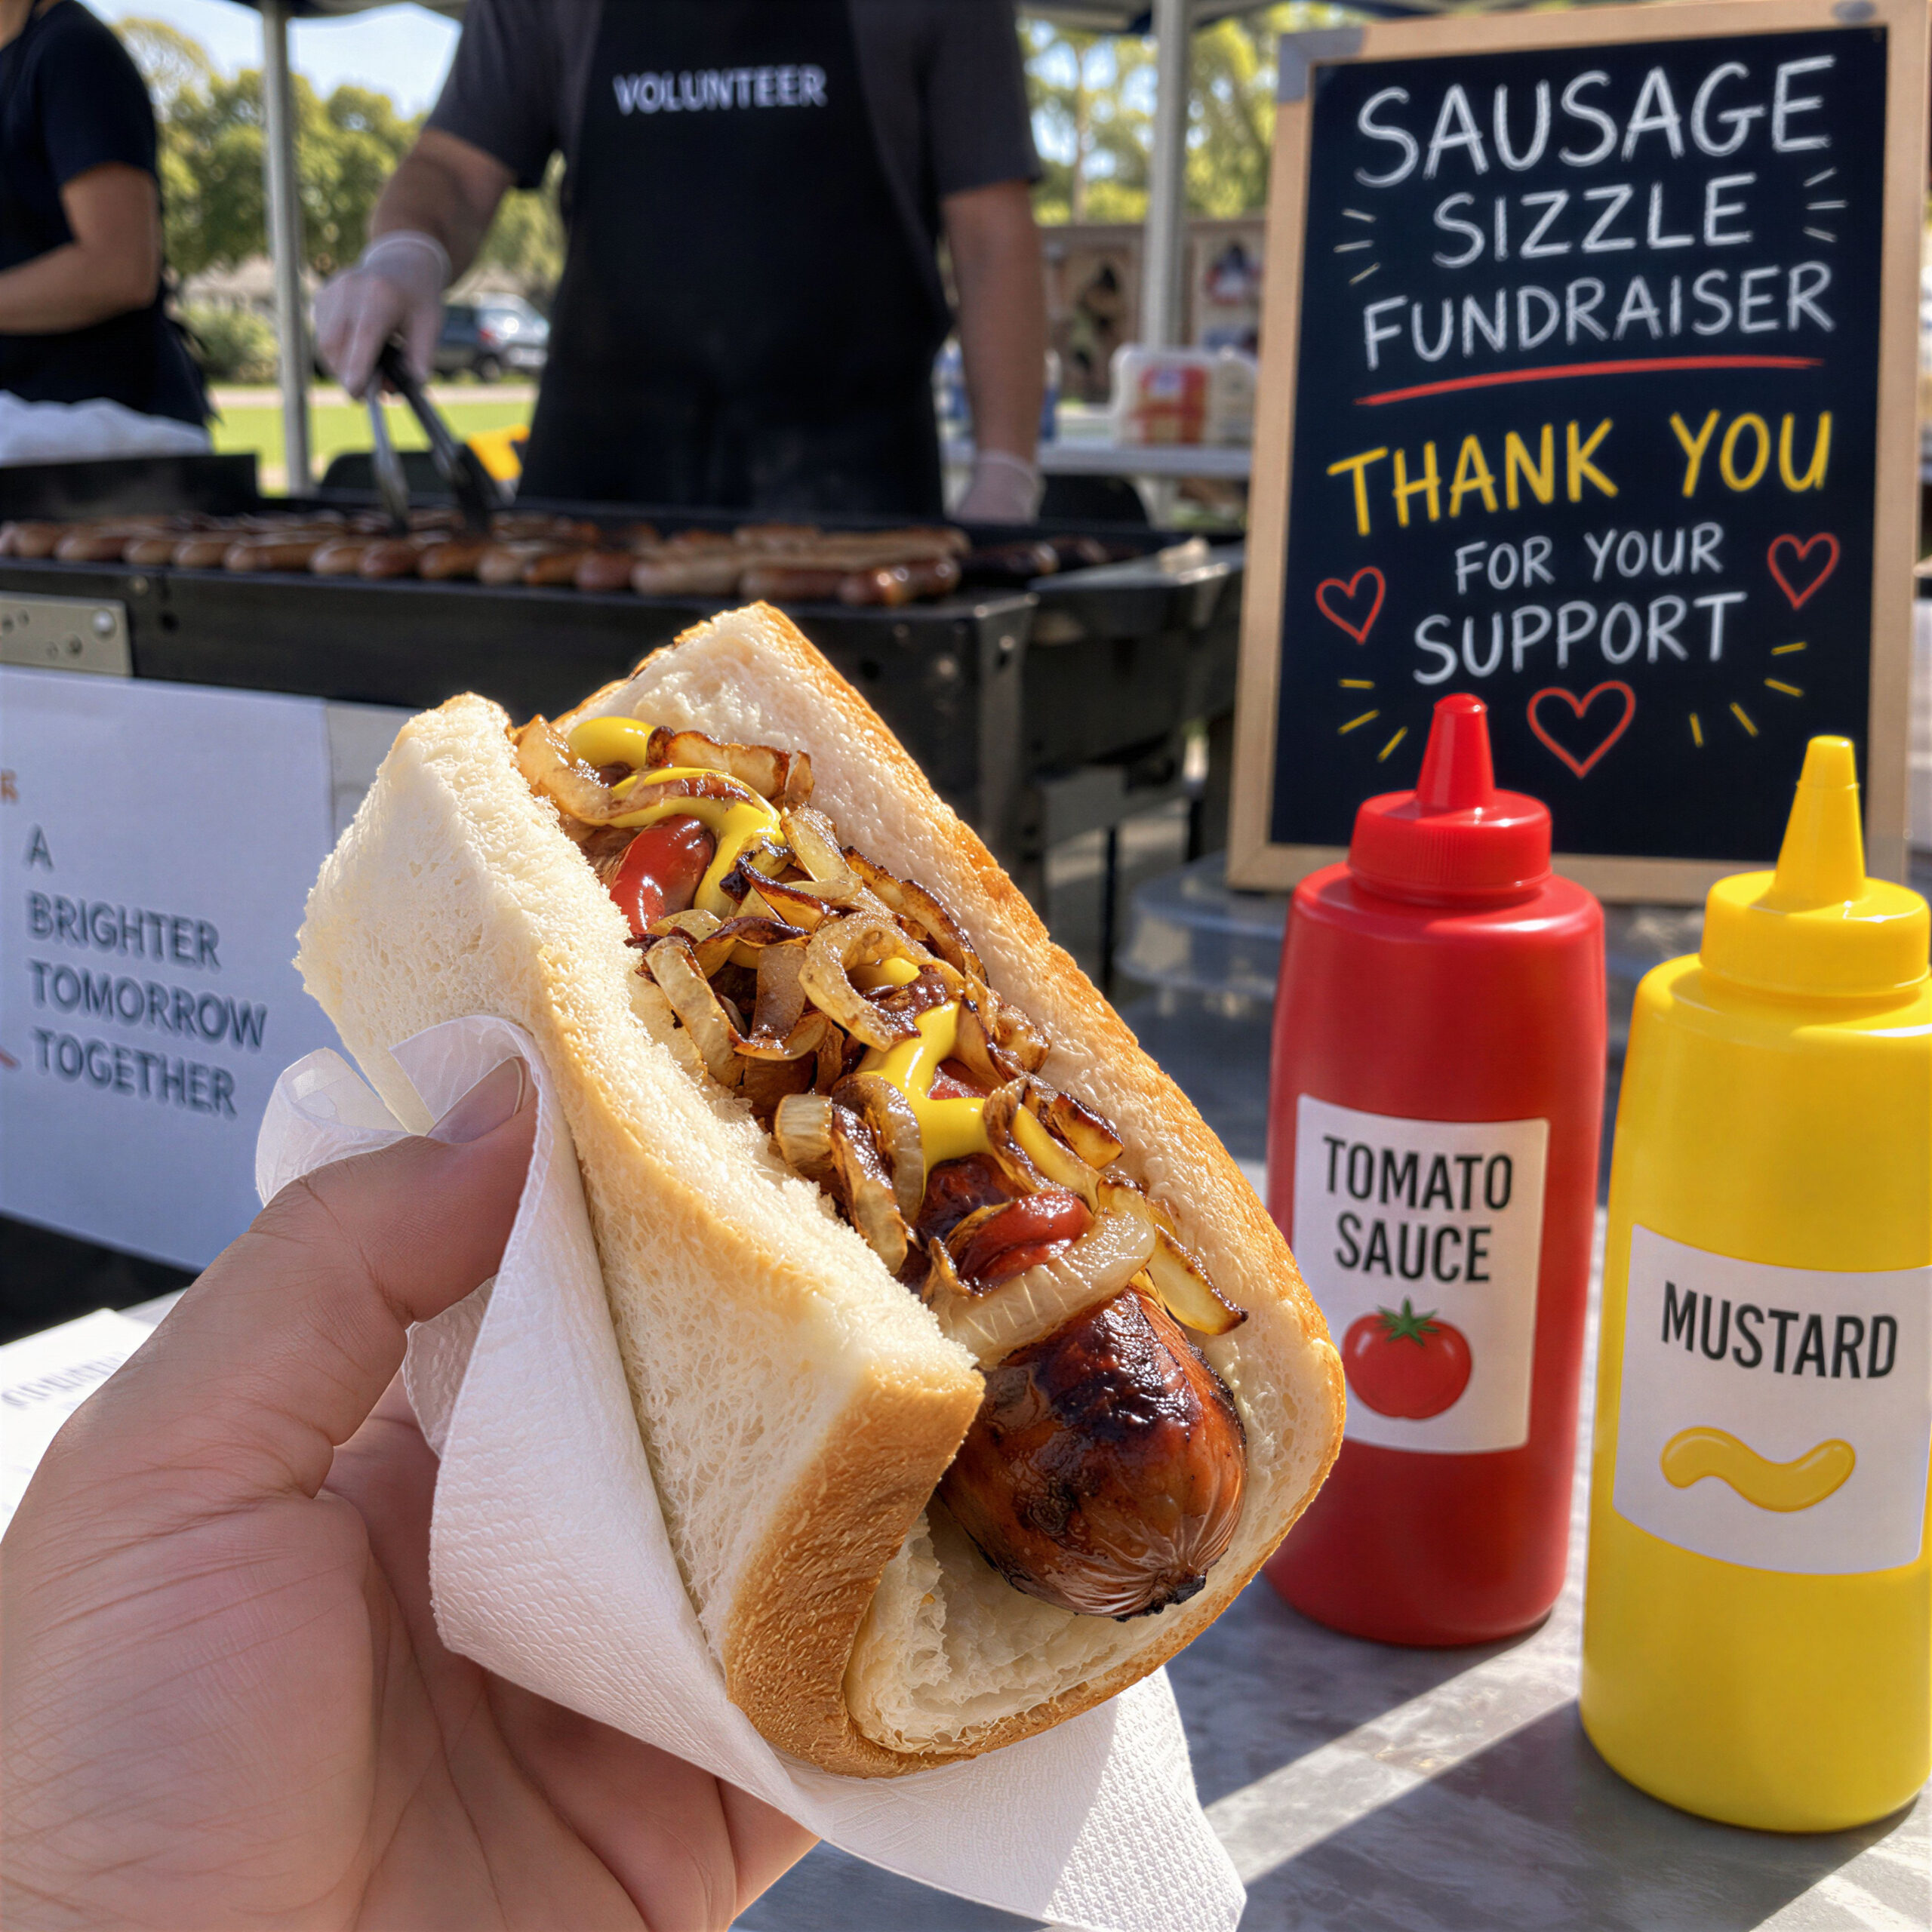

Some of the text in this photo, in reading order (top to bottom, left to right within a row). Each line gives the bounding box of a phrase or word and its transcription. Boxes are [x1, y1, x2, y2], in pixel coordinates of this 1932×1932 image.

[613, 64, 828, 115] VOLUNTEER
[1355, 54, 1835, 187] SAUSAGE
[1433, 173, 1757, 269] SIZZLE
[1364, 262, 1834, 370] FUNDRAISER
[1326, 410, 1832, 536] THANK YOU
[1455, 521, 1724, 594] FOR YOUR
[1413, 592, 1747, 685] SUPPORT
[26, 825, 54, 872] A
[27, 891, 221, 970] BRIGHTER
[29, 958, 268, 1050] TOMORROW
[32, 1027, 237, 1116] TOGETHER
[1323, 1135, 1514, 1212] TOMATO
[1334, 1211, 1493, 1284] SAUCE
[1661, 1281, 1899, 1380] MUSTARD
